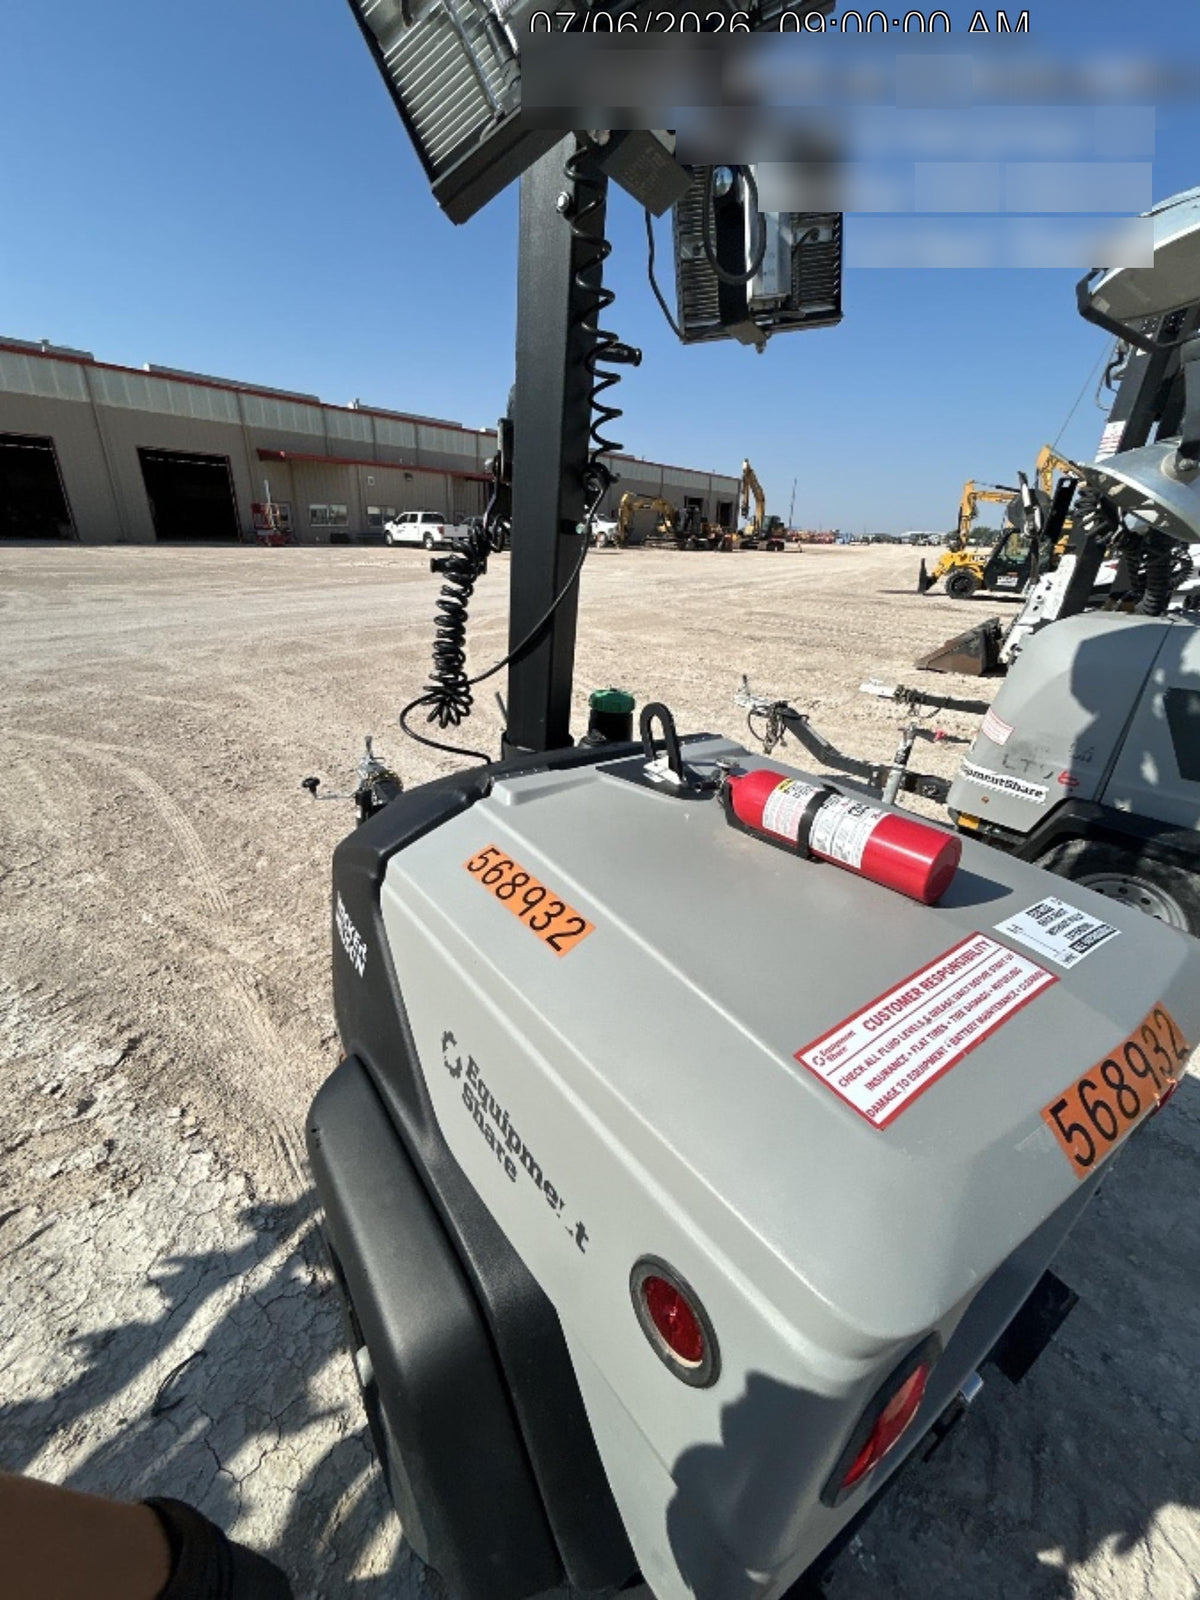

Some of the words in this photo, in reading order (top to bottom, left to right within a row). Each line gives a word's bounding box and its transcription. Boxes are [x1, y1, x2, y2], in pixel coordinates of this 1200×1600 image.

[466, 847, 586, 952] 568932
[862, 987, 925, 1031] CUSTOMER
[919, 940, 992, 991] RESPONSIBILITY
[839, 1065, 868, 1087] CHECK
[864, 1054, 881, 1067] ALL
[877, 1038, 900, 1056] FLUID
[897, 1020, 925, 1040] LEVELS
[864, 1054, 909, 1091] INSURANCE
[910, 1037, 930, 1054] FLAT
[926, 1024, 948, 1040] TIRES
[949, 1009, 967, 1022] TIRE
[865, 1086, 902, 1118] DAMAGE
[896, 1079, 910, 1090] TO
[906, 1046, 948, 1081] EQUIPMENT
[949, 1020, 979, 1046] BATTERY
[1048, 1009, 1188, 1167] 568932
[461, 1081, 517, 1184] Share
[465, 1055, 589, 1255] Equipmet
